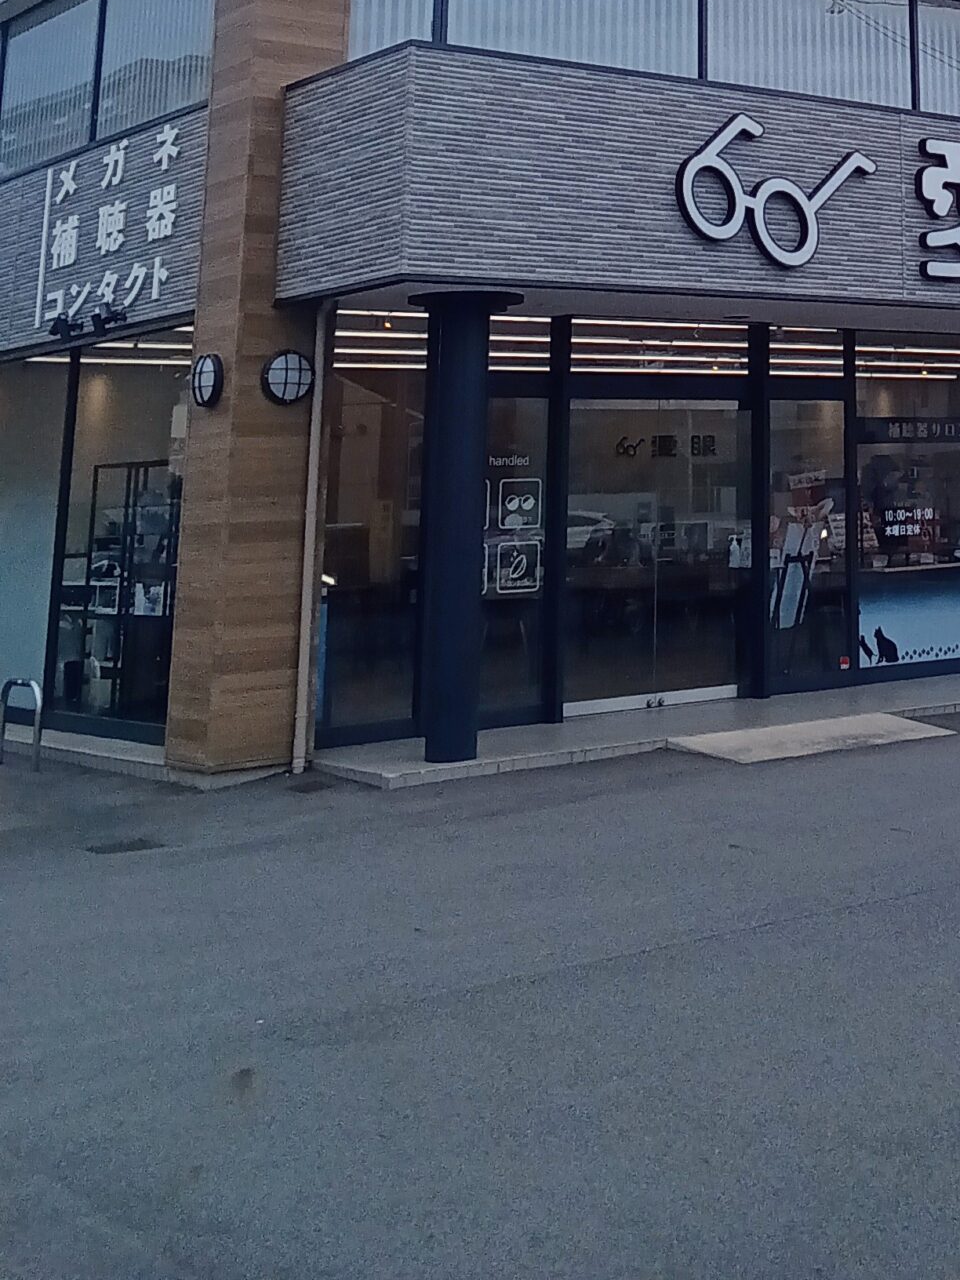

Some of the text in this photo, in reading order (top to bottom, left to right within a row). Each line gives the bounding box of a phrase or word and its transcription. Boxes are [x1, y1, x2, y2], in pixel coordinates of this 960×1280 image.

[55, 124, 181, 204] メガネ
[51, 183, 179, 270] 補聴器
[44, 256, 170, 321] コンタクト
[489, 454, 530, 466] handled
